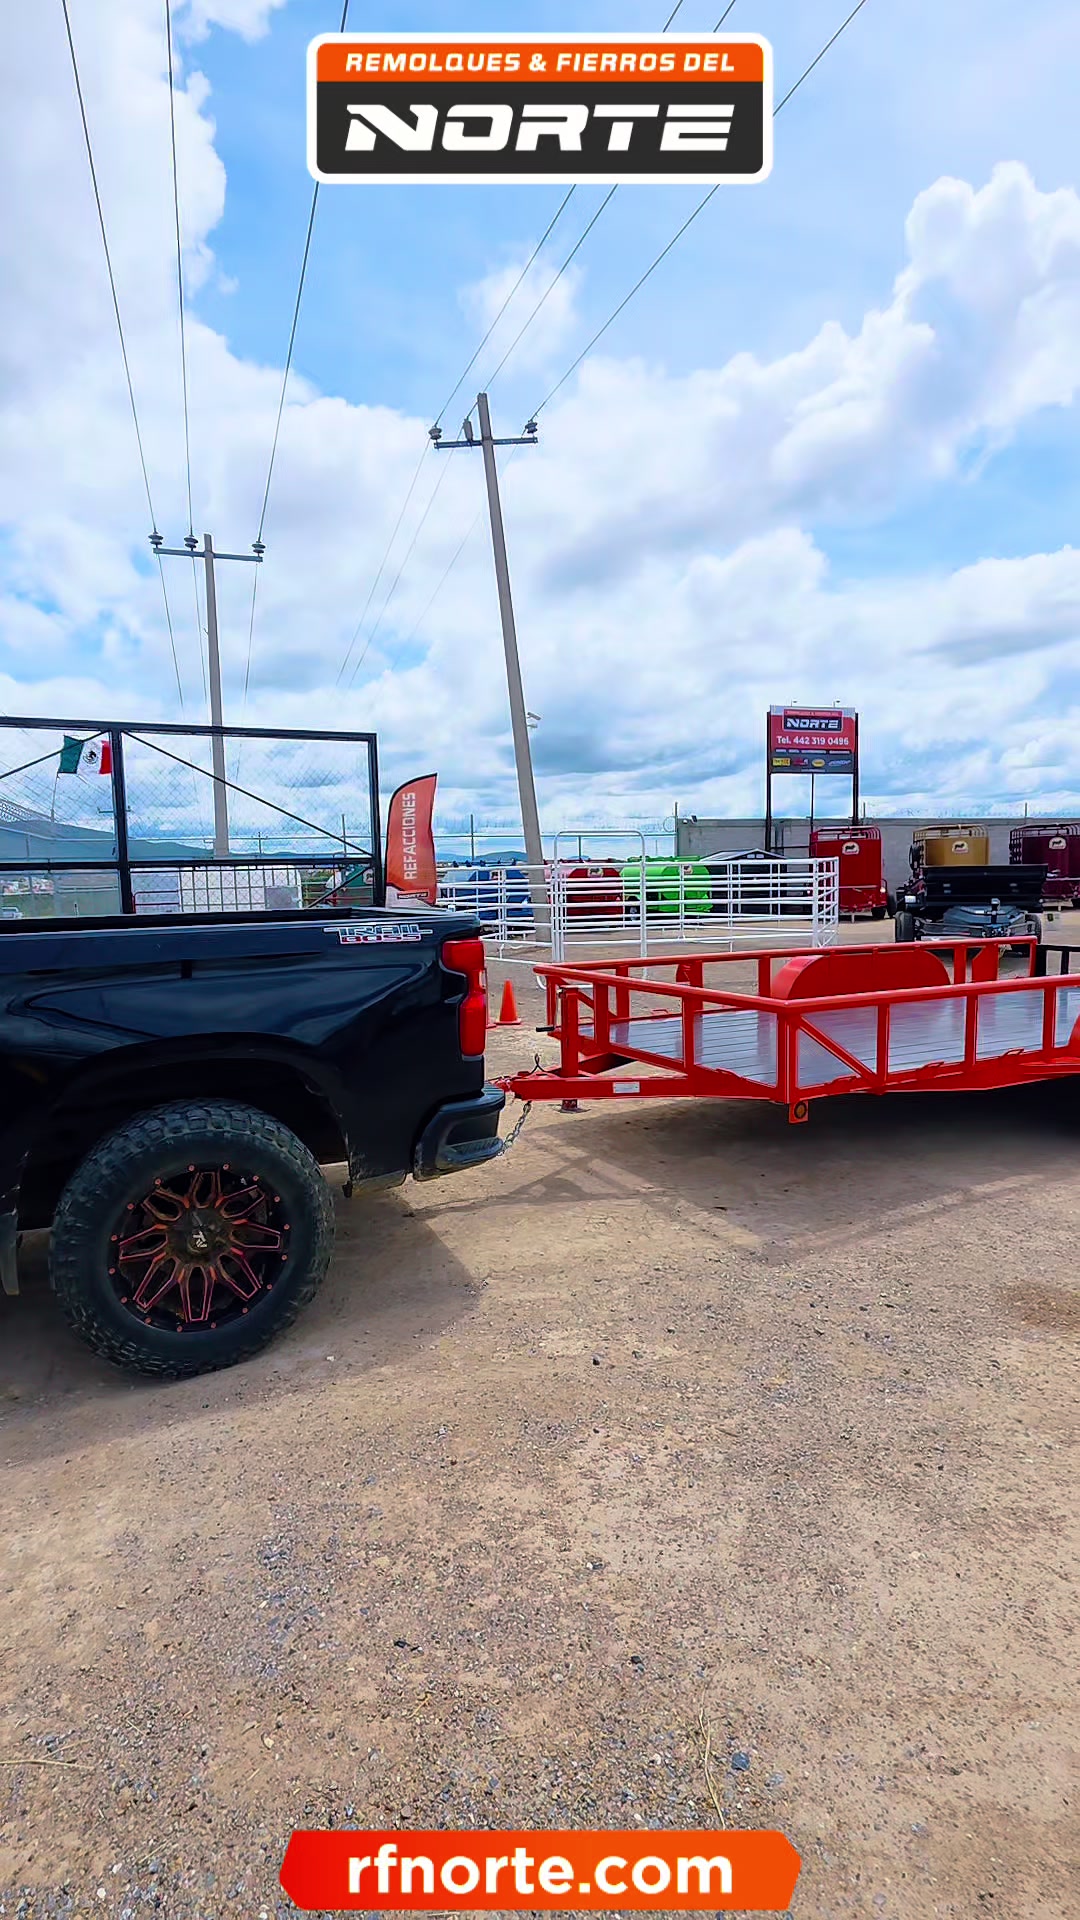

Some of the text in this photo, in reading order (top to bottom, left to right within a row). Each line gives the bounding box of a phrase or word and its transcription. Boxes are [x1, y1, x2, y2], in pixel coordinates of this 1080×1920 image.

[786, 718, 838, 728] NORTE
[776, 735, 791, 744] Tel.
[793, 736, 810, 744] 442
[811, 736, 825, 744] 319
[402, 792, 417, 880] REFACCIONES
